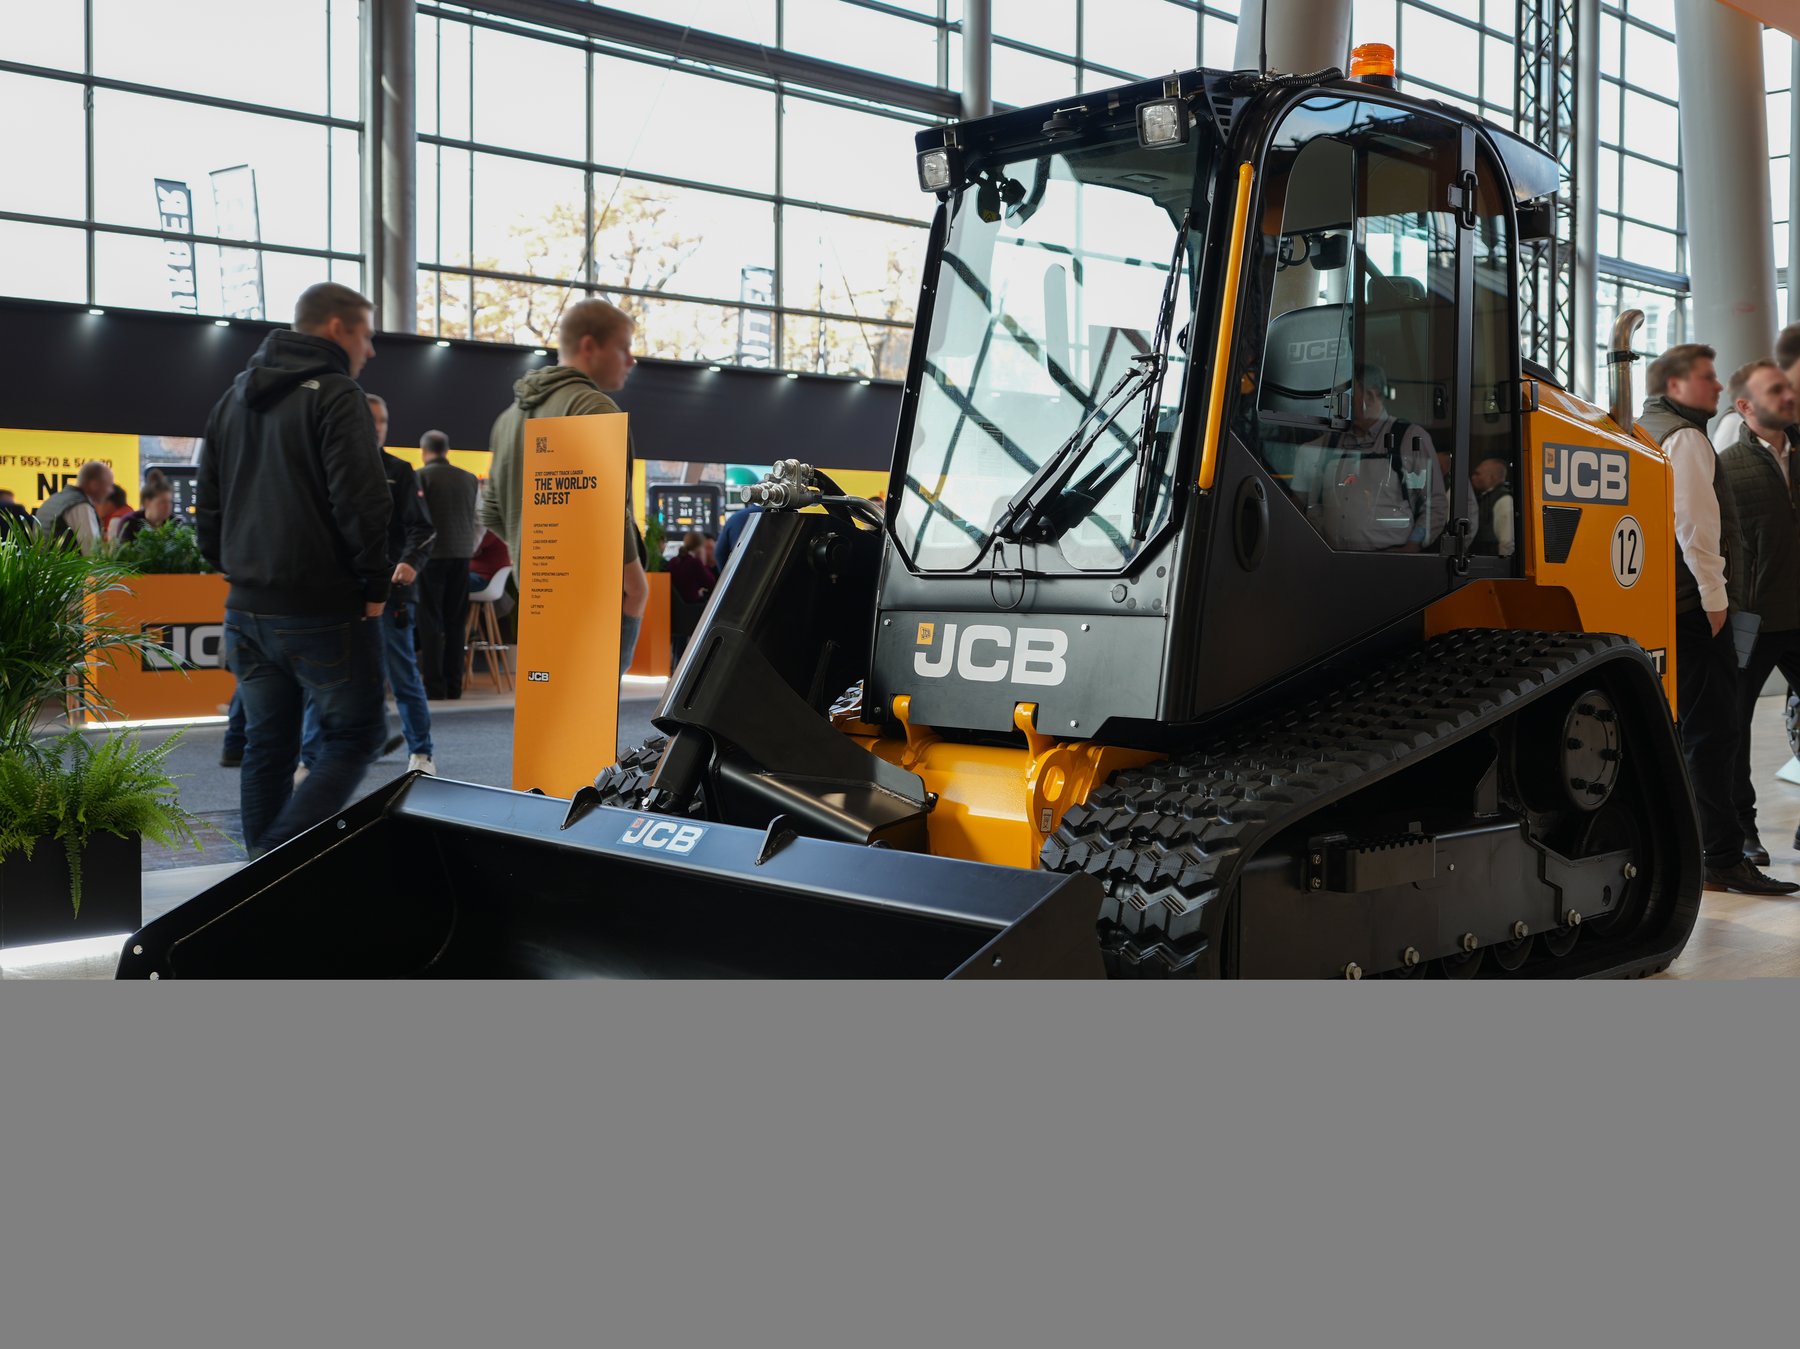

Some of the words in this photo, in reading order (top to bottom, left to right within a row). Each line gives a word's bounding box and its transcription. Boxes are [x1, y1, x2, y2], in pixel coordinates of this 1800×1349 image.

[1289, 339, 1347, 362] JCB
[20, 455, 59, 467] 555-70
[534, 477, 552, 490] THE
[555, 476, 597, 490] WORLD'S
[1544, 449, 1628, 500] JCB
[534, 491, 570, 505] SAFEST
[1618, 528, 1637, 575] 12
[145, 625, 226, 668] JC
[913, 623, 1069, 686] JCB
[1648, 650, 1665, 674] T
[528, 671, 549, 682] JCB
[622, 819, 704, 853] JCB
